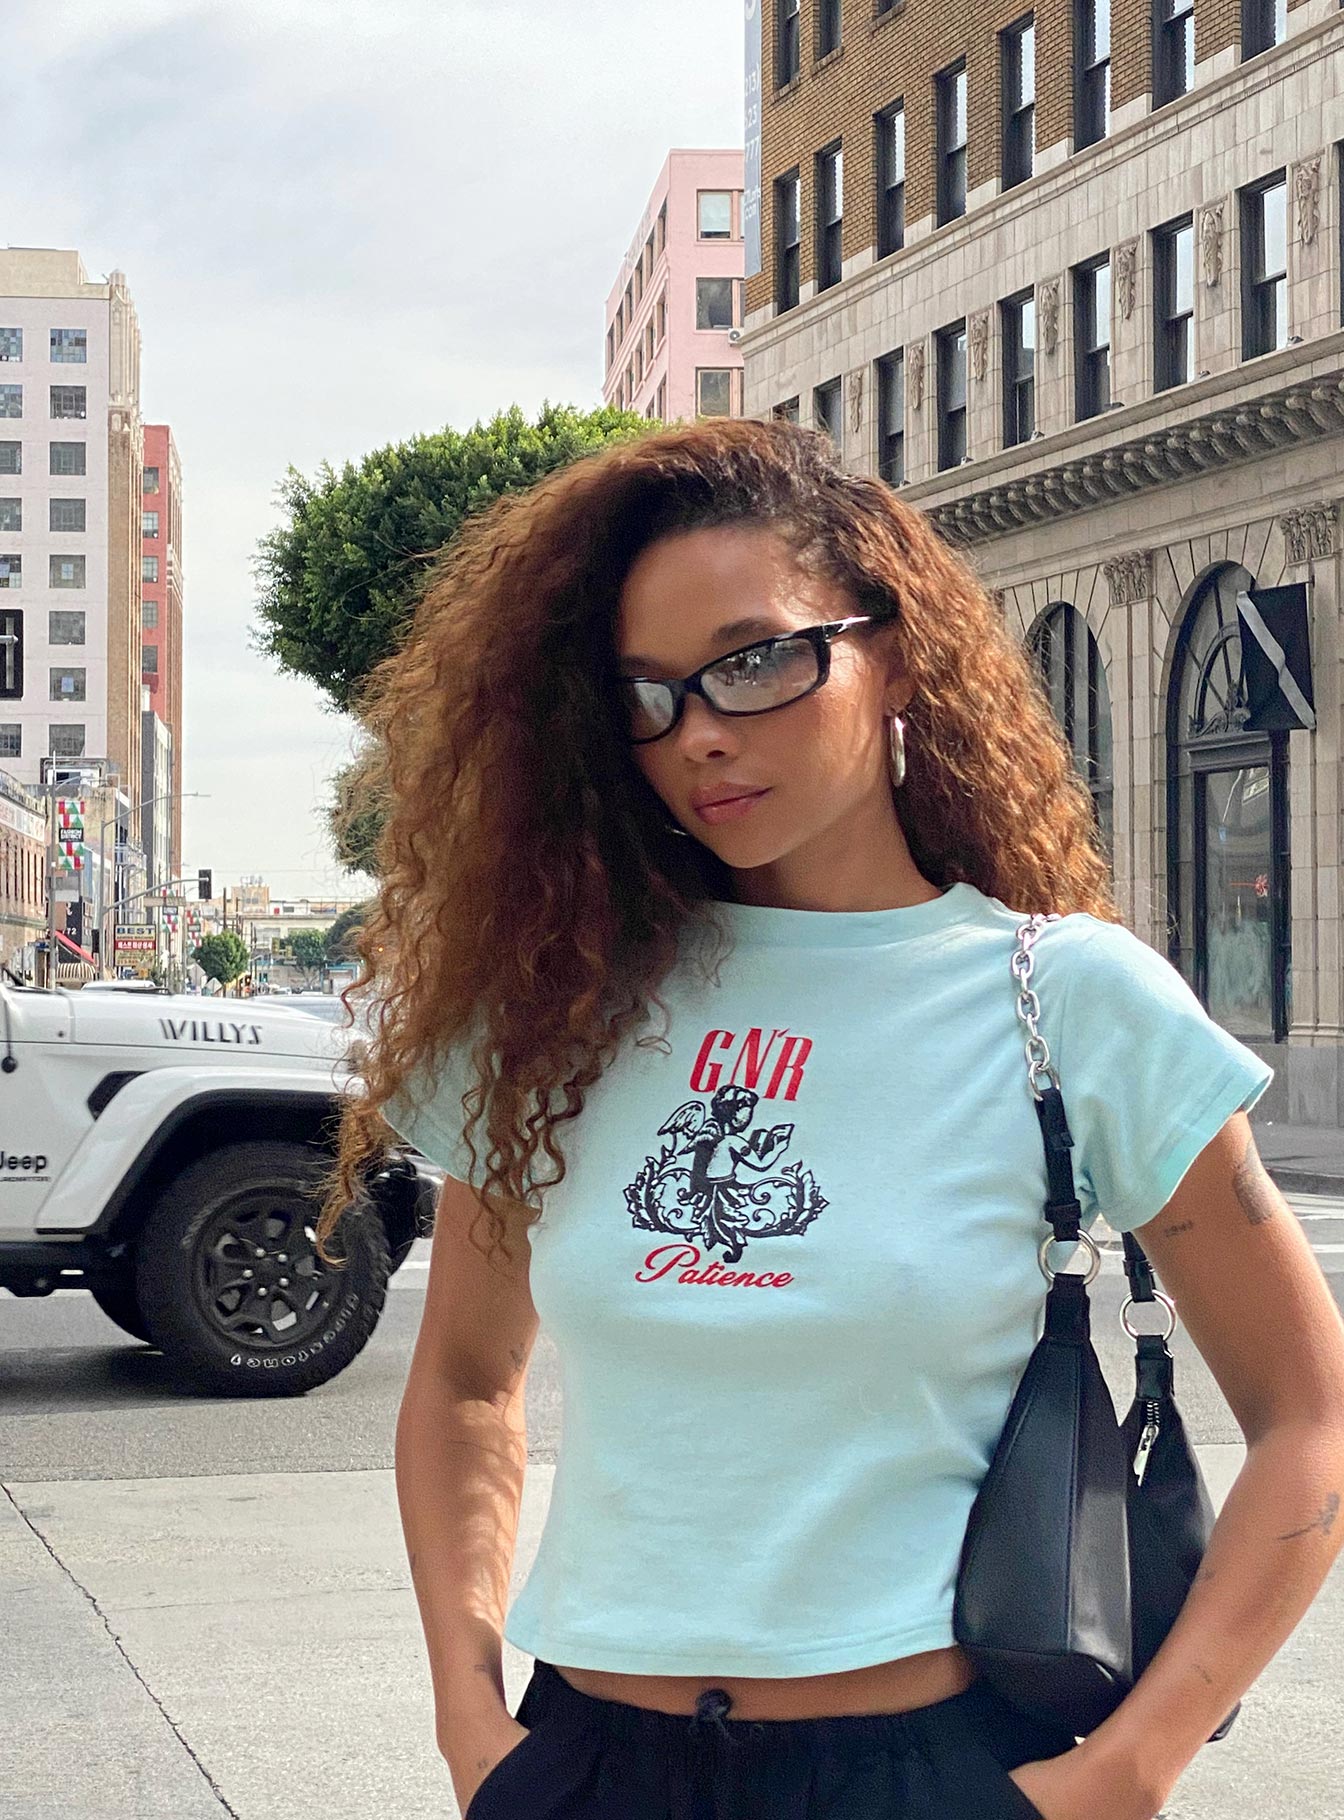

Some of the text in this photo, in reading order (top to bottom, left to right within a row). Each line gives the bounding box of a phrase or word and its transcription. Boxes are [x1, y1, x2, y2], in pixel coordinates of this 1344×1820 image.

[116, 927, 155, 935] BEST
[158, 1018, 262, 1045] WILLYS
[0, 1150, 48, 1173] Jeep
[635, 1244, 794, 1288] Patience
